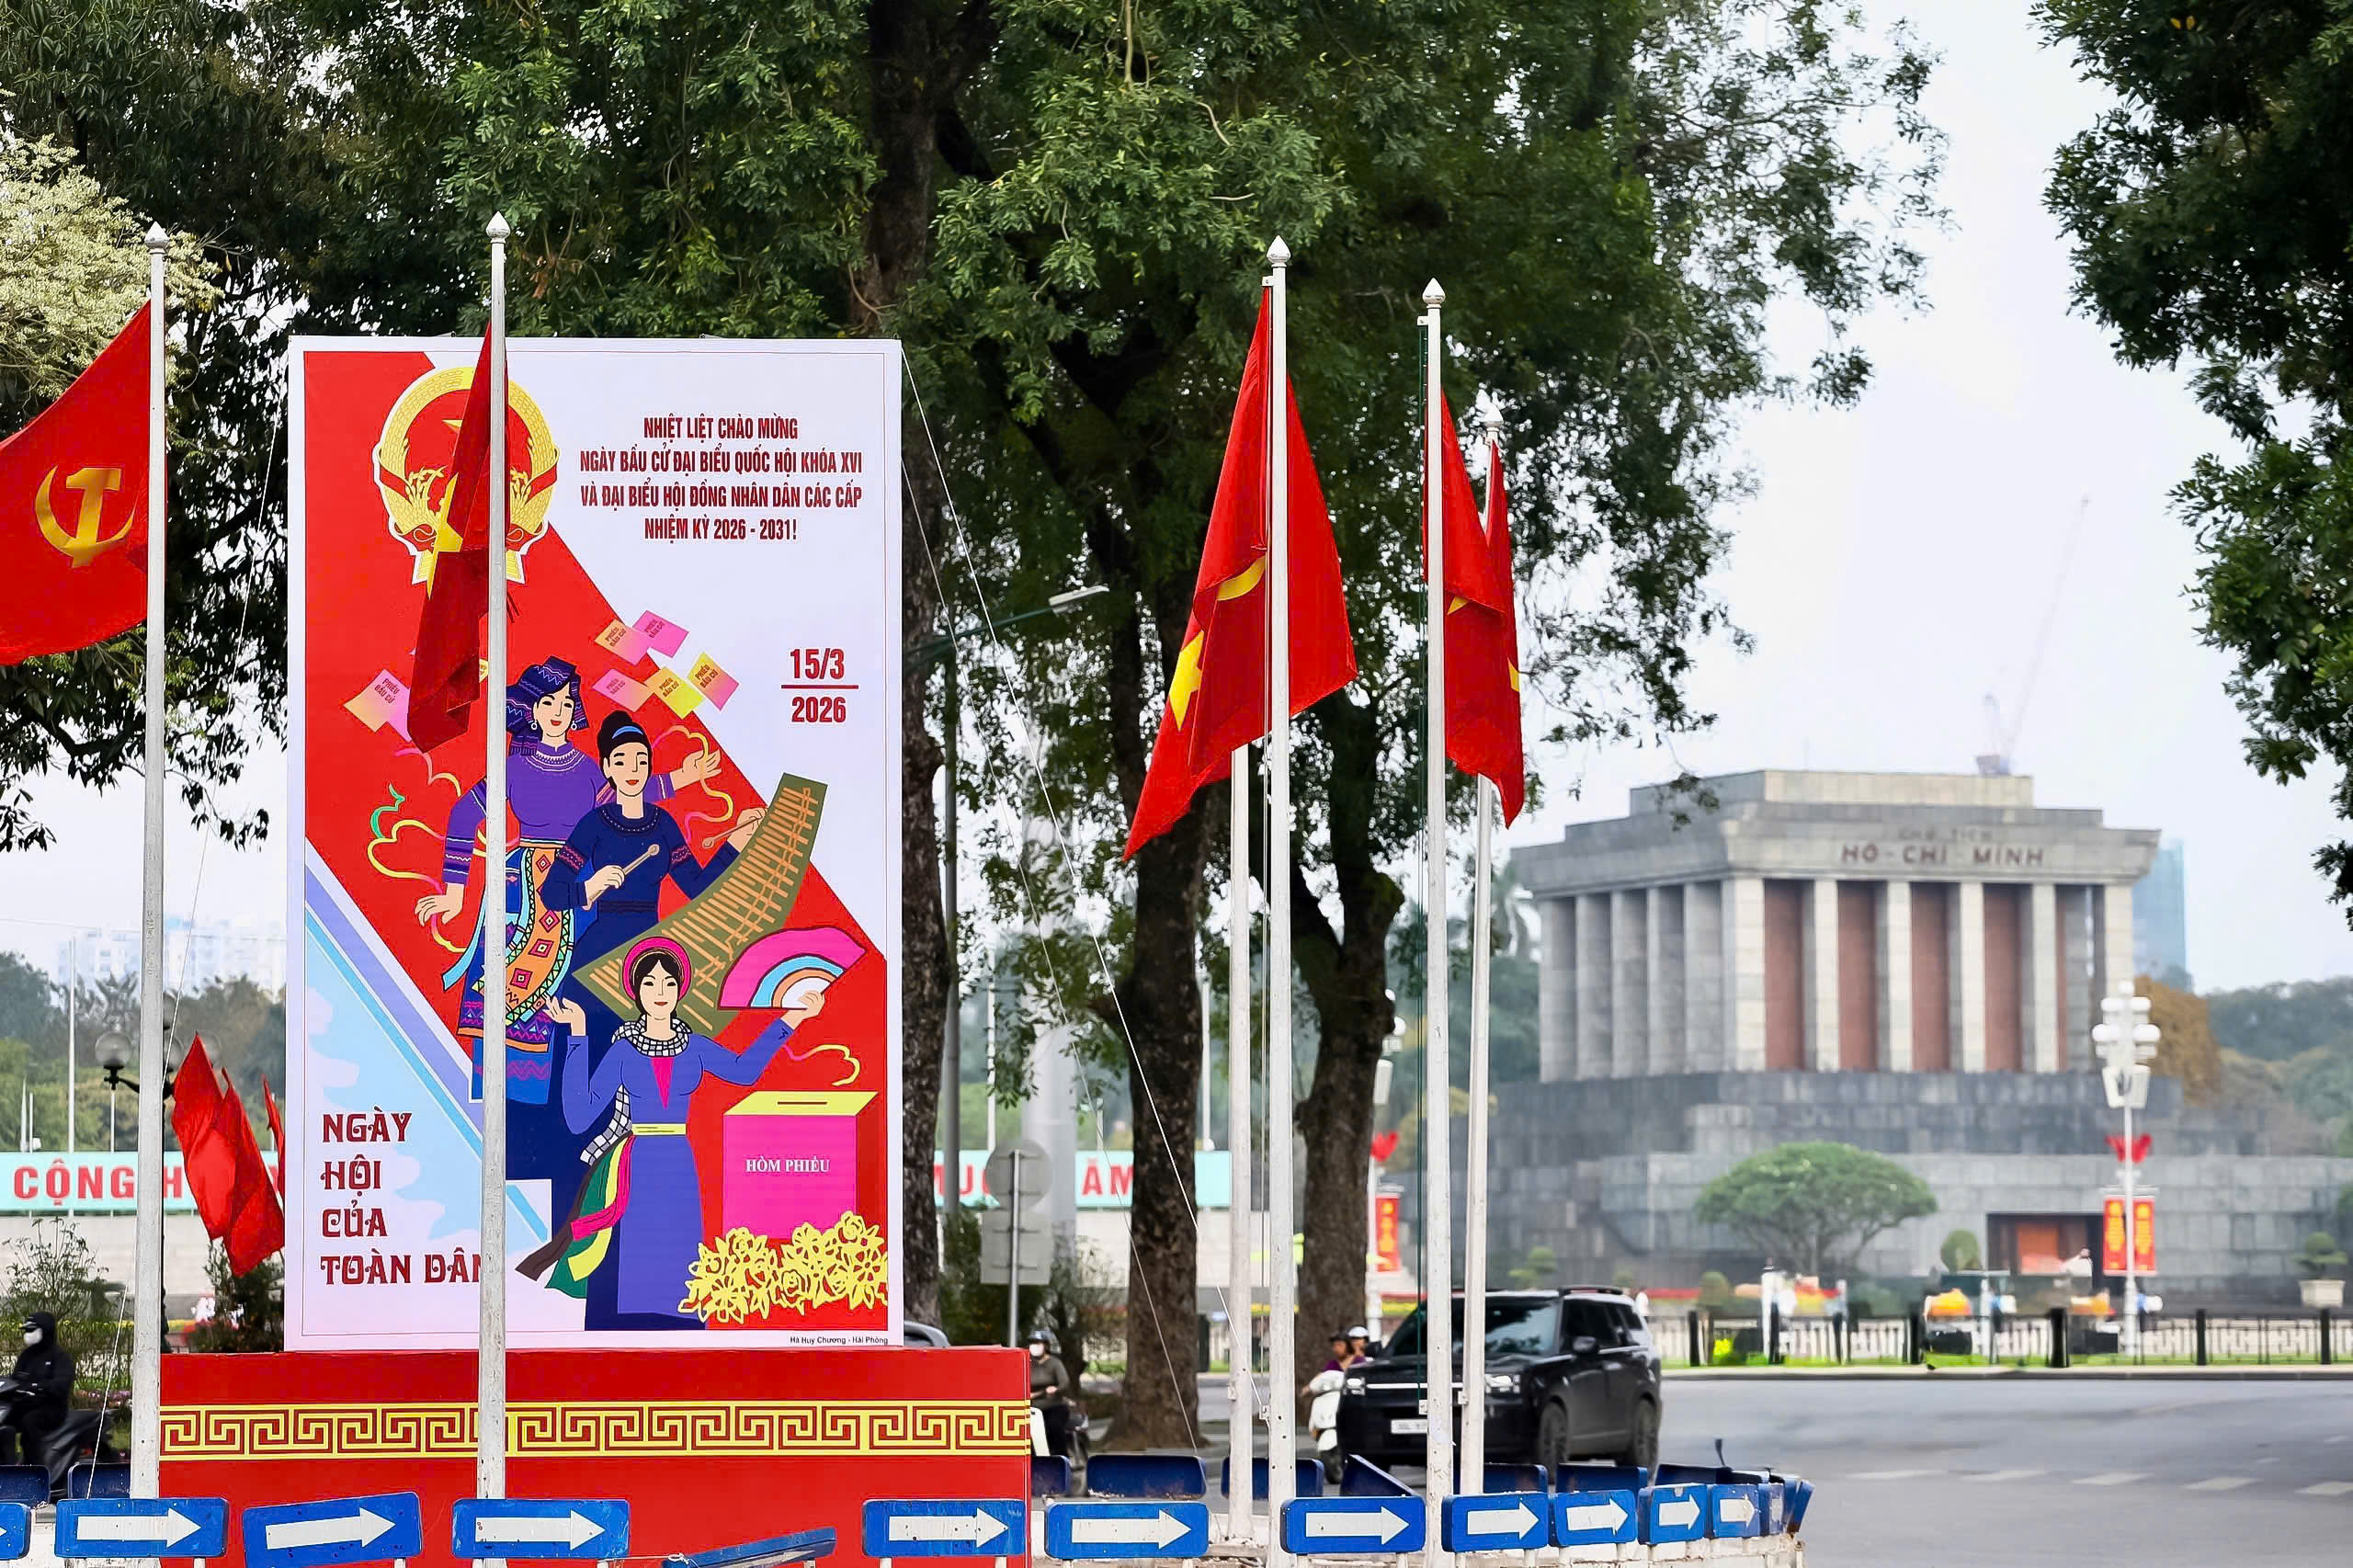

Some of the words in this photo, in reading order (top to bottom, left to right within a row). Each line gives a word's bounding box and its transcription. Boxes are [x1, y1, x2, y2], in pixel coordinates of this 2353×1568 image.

[644, 413, 683, 443] NHIỆT
[687, 413, 713, 443] LIỆT
[718, 414, 754, 439] CHÀO
[757, 413, 798, 439] MỪNG
[580, 446, 616, 472] NGÀY
[620, 444, 647, 472] BẦU
[651, 441, 671, 472] CỬ
[673, 451, 696, 476] ĐẠI
[699, 443, 731, 472] BIỂU
[734, 444, 770, 474] QUỐC
[774, 448, 796, 477] HỘI
[801, 447, 837, 472] KHÓA
[840, 451, 862, 472] XVI
[580, 481, 598, 506] VÀ
[601, 485, 624, 511] ĐẠI
[629, 477, 659, 506] BIỂU
[663, 482, 686, 511] HỘI
[689, 479, 727, 507] ĐỒNG
[731, 482, 768, 507] NHÂN
[772, 482, 801, 507] DÂN
[804, 482, 832, 507] CÁC
[835, 479, 862, 507] CẤP
[644, 514, 688, 543] NHIỆM
[692, 514, 710, 539] KỲ
[714, 518, 746, 540] 2026
[759, 518, 797, 540] 2031!
[790, 648, 846, 680] 15/3
[791, 696, 847, 723] 2026
[1973, 845, 2044, 866] MINH
[323, 1106, 413, 1142] NGÀY
[320, 1153, 381, 1197] HỘI
[745, 1155, 781, 1172] HÒM
[785, 1155, 831, 1172] PHIẾU
[1082, 1157, 1134, 1196] ĂM
[14, 1157, 134, 1206] CỘNG
[322, 1199, 388, 1238] CỦA
[320, 1248, 411, 1285] TOÀN
[801, 1335, 815, 1346] Huy
